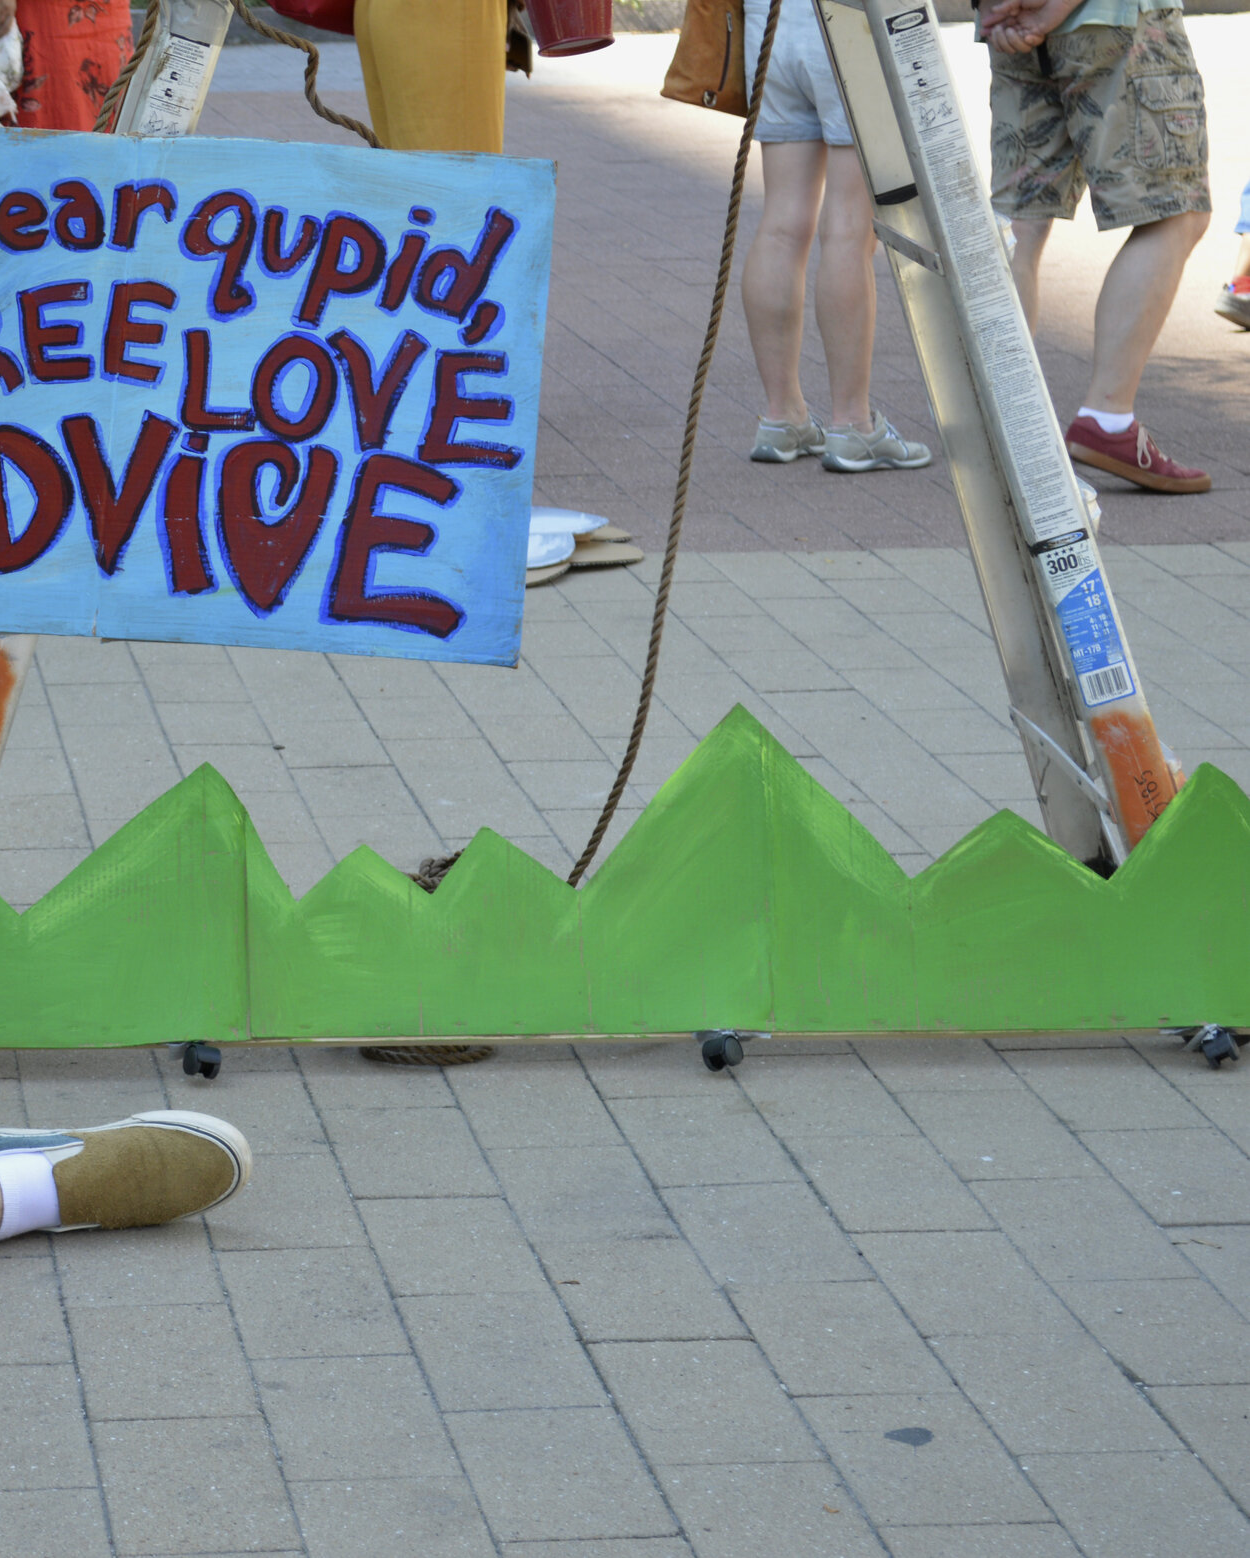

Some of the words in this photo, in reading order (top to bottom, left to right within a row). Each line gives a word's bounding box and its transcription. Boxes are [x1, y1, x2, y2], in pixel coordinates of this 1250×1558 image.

[179, 188, 520, 347] qupid,
[181, 326, 525, 470] LOVE
[1046, 553, 1078, 575] 300
